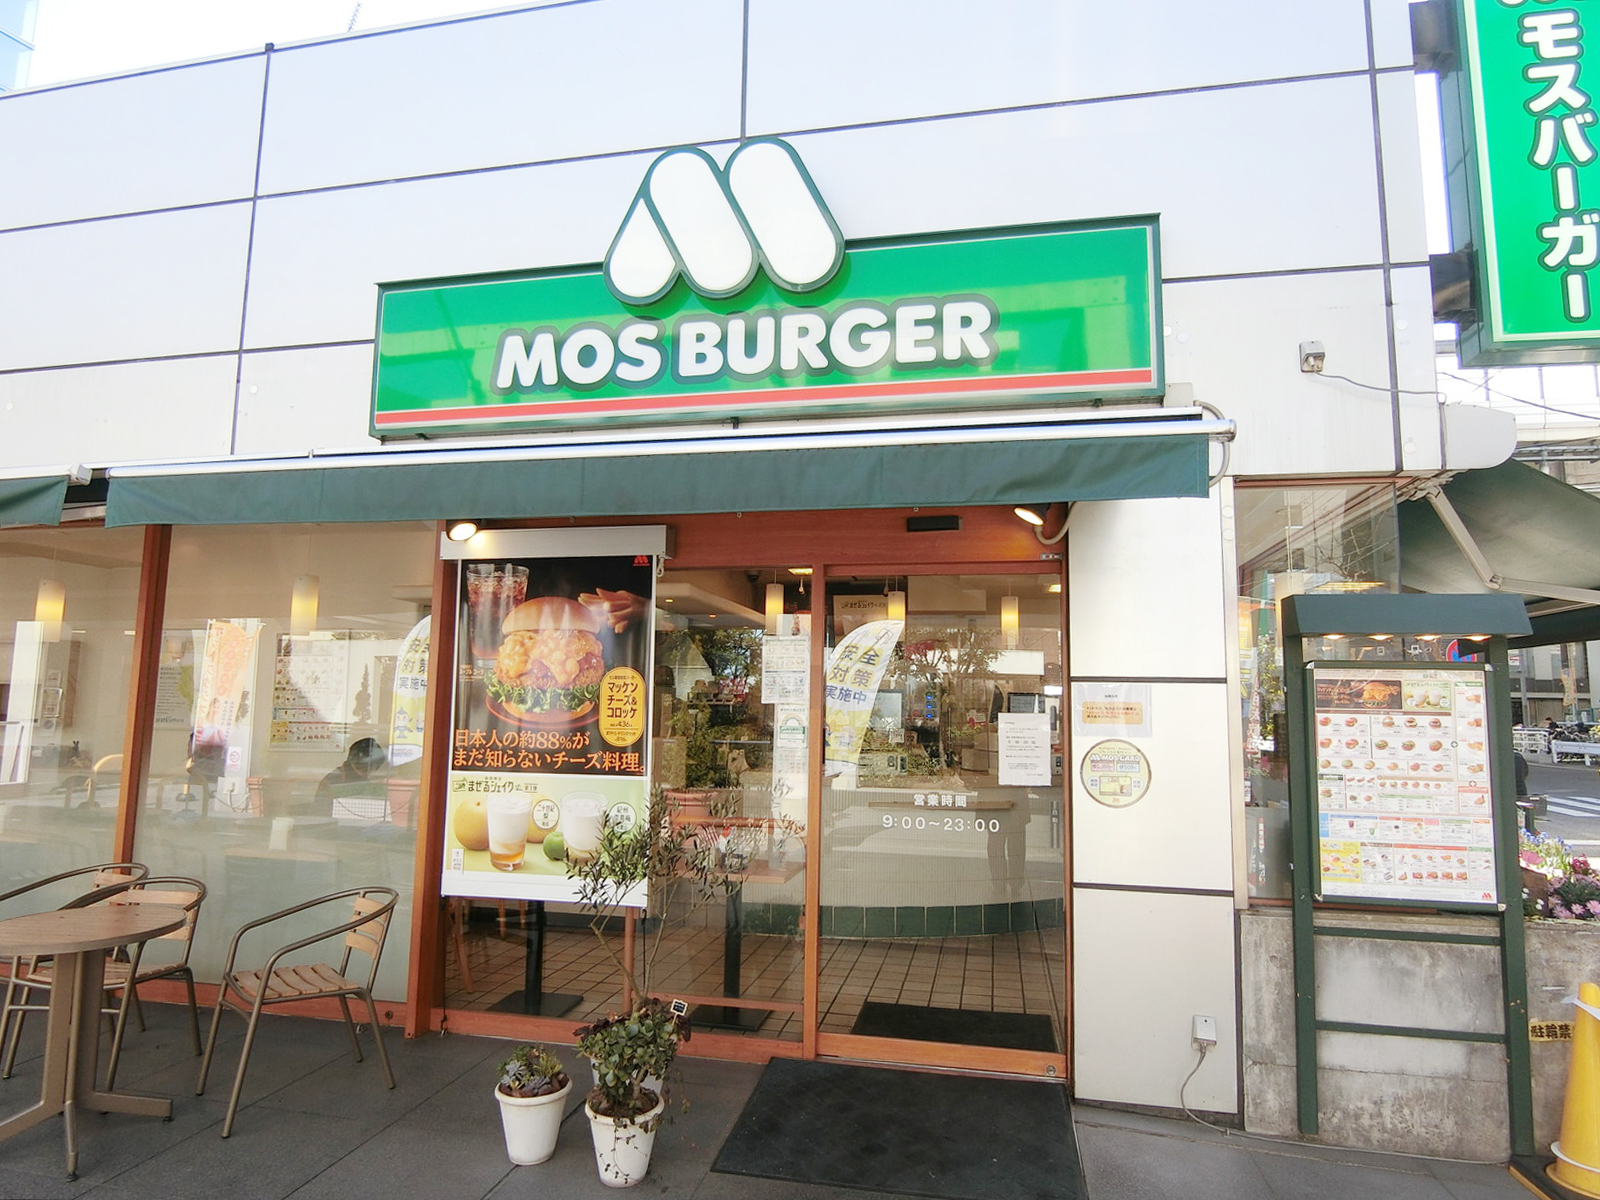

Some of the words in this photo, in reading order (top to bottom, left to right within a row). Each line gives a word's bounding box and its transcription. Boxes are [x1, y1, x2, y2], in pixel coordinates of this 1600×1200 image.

[1518, 9, 1600, 321] モスバーガー
[496, 324, 662, 391] MOS
[678, 301, 993, 380] BURGER
[828, 668, 875, 688] 対策
[607, 682, 639, 693] マッケン
[825, 685, 867, 705] 実施中
[607, 694, 638, 706] チーズ&
[606, 707, 638, 719] コロッケ
[454, 729, 590, 750] 日本人の約88%が
[453, 749, 646, 772] まだ知らないチーズ料理。
[468, 780, 514, 793] まぜるシェイク
[913, 793, 968, 808] 営業時間
[1530, 1022, 1575, 1039] 駐輪禁
